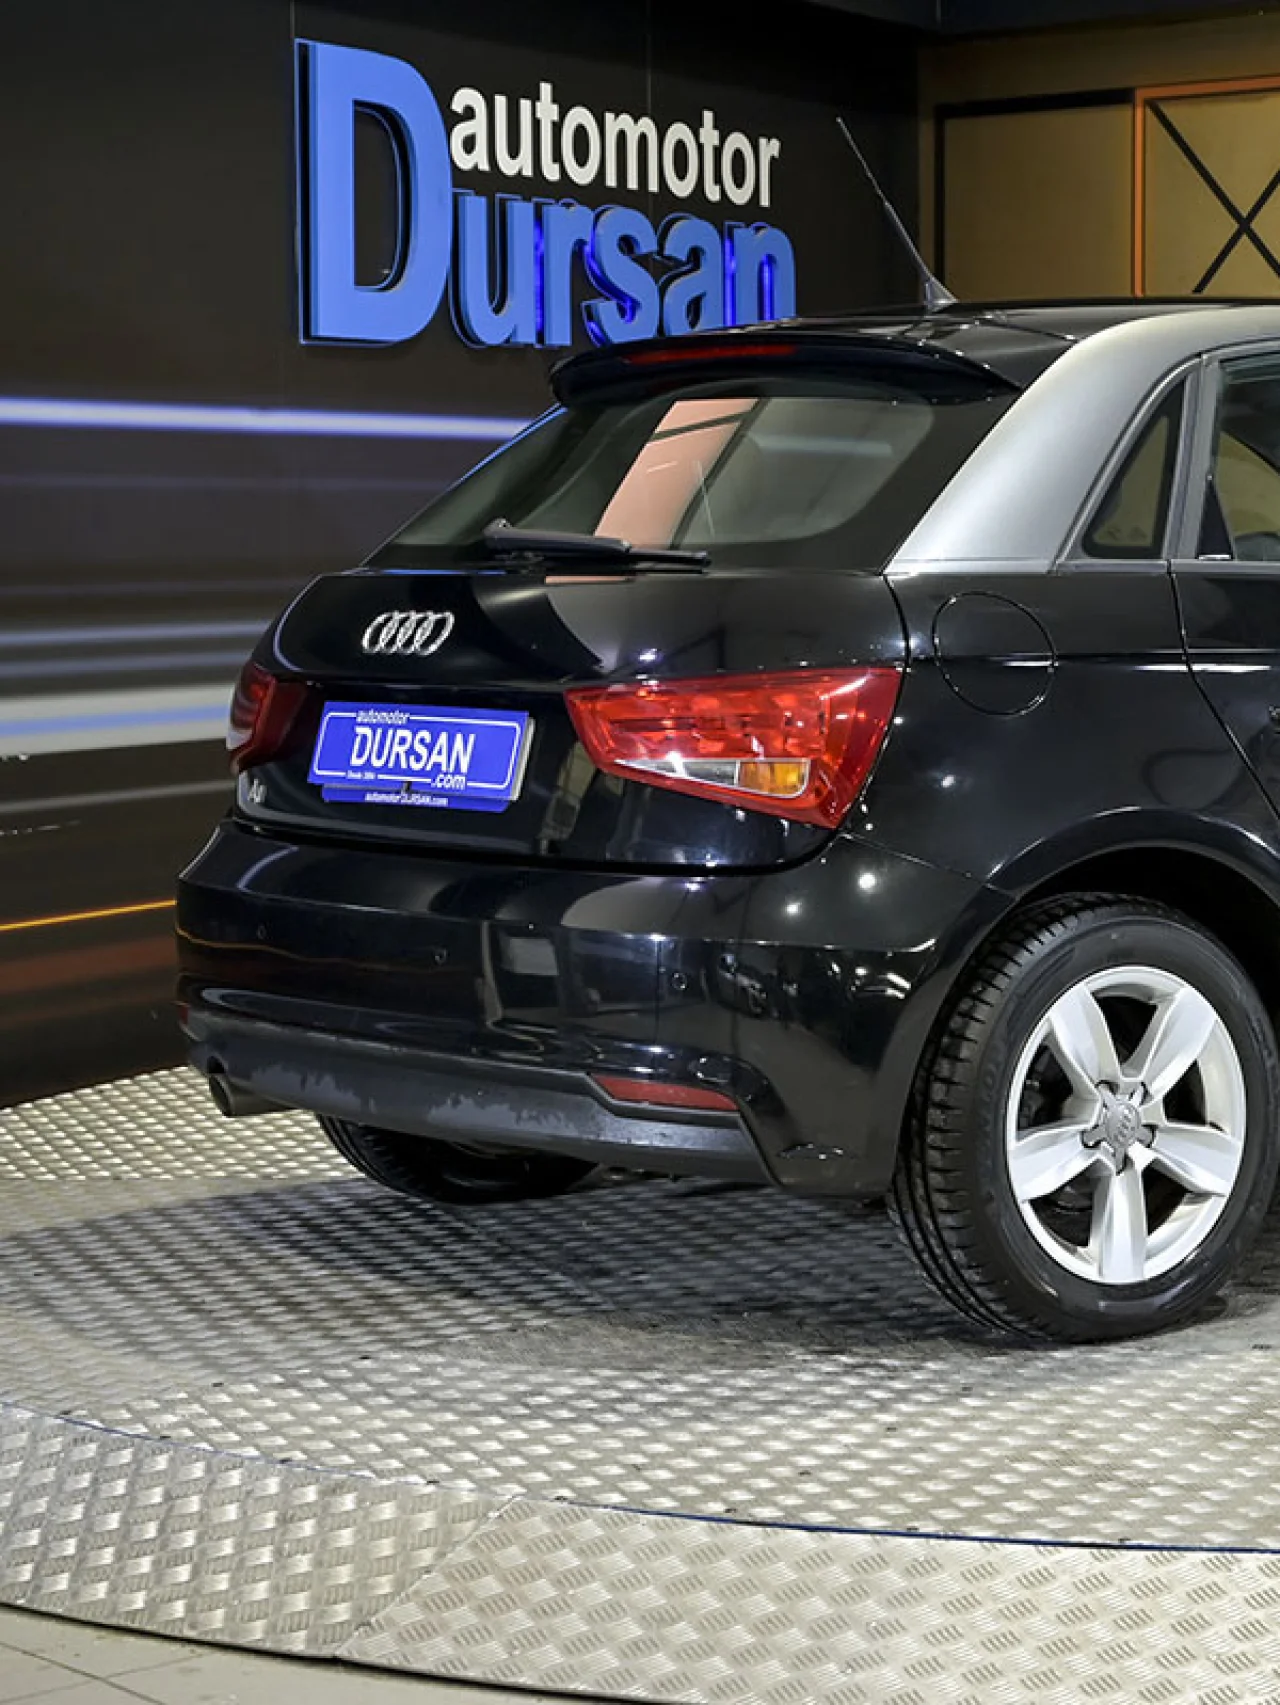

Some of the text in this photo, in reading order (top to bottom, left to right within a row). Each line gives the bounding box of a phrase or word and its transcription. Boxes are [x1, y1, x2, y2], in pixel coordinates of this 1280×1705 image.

[450, 82, 780, 207] automotor
[294, 38, 797, 348] Dursan
[356, 708, 410, 726] automotor
[350, 725, 476, 774] DURSAN
[431, 773, 467, 791] .com
